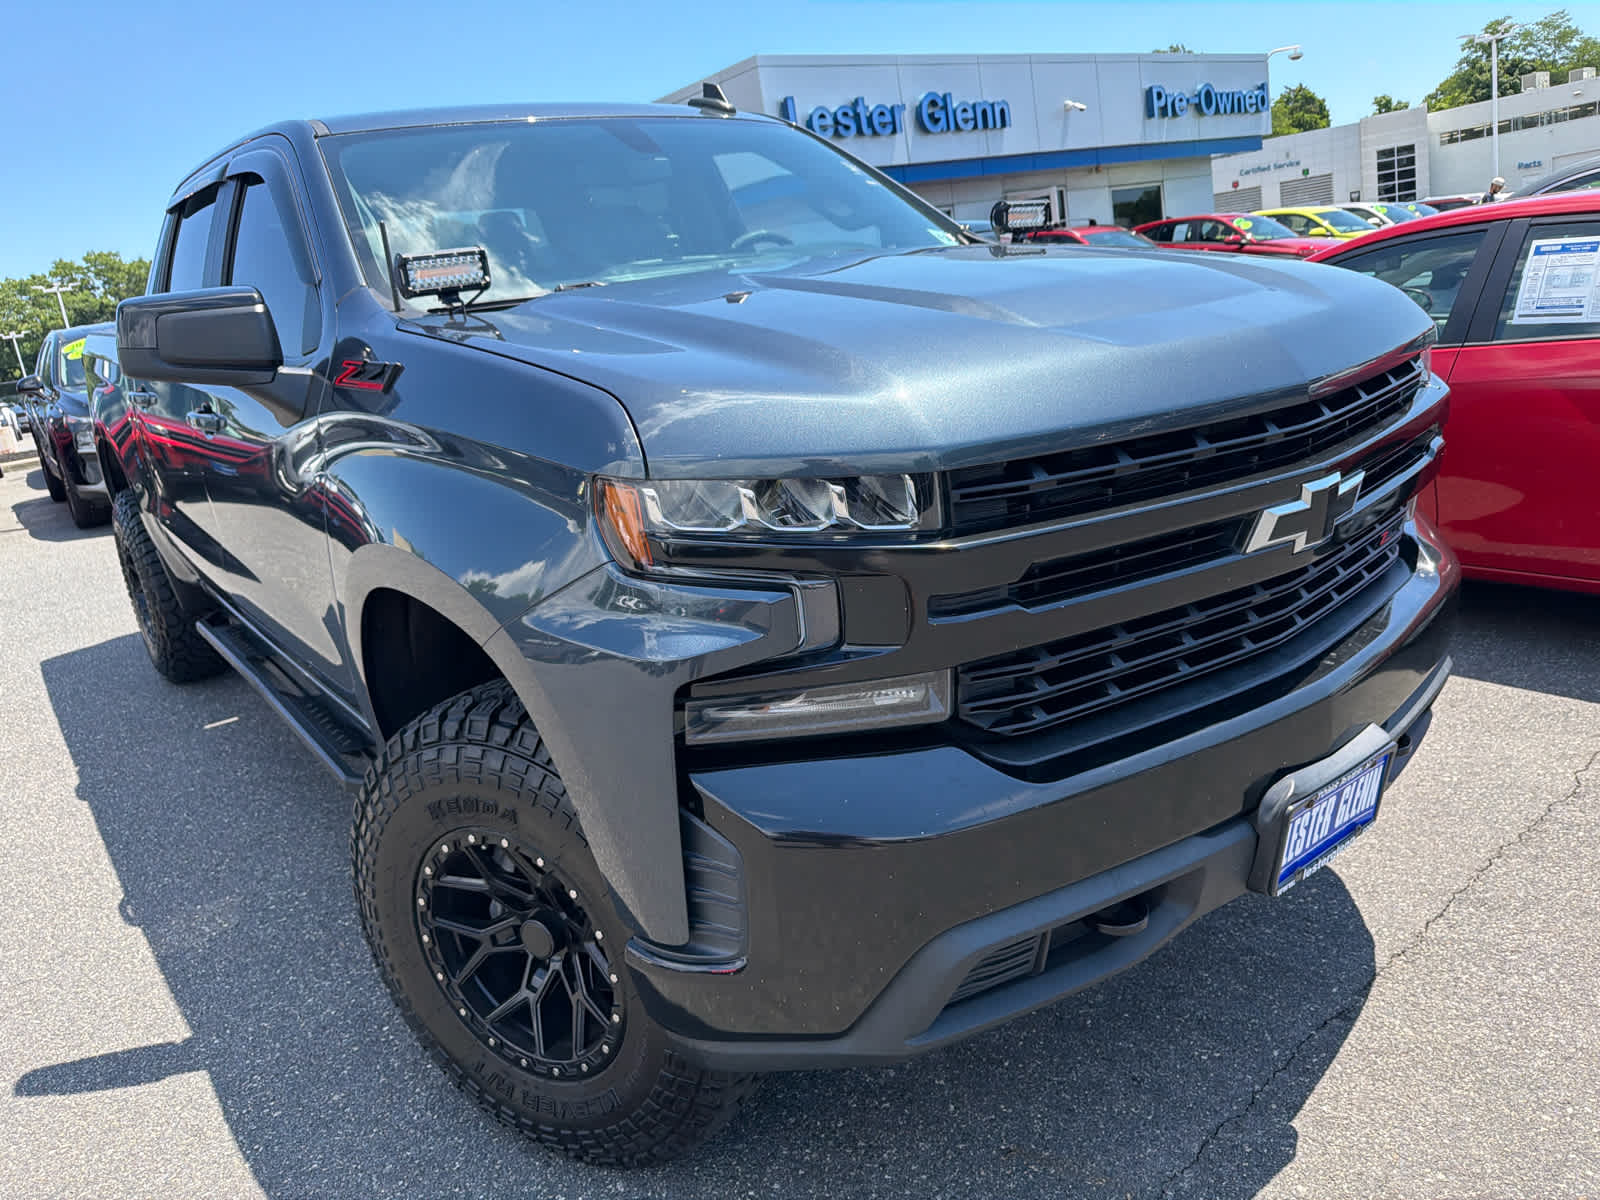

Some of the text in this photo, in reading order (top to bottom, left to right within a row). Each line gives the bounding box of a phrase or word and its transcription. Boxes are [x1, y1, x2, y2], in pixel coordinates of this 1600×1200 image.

[917, 91, 1011, 133] Glenn
[1145, 83, 1269, 118] Pre-Owned
[1240, 160, 1300, 176] Certified Service
[427, 796, 517, 824] KENDA
[1335, 765, 1385, 829] GLENN
